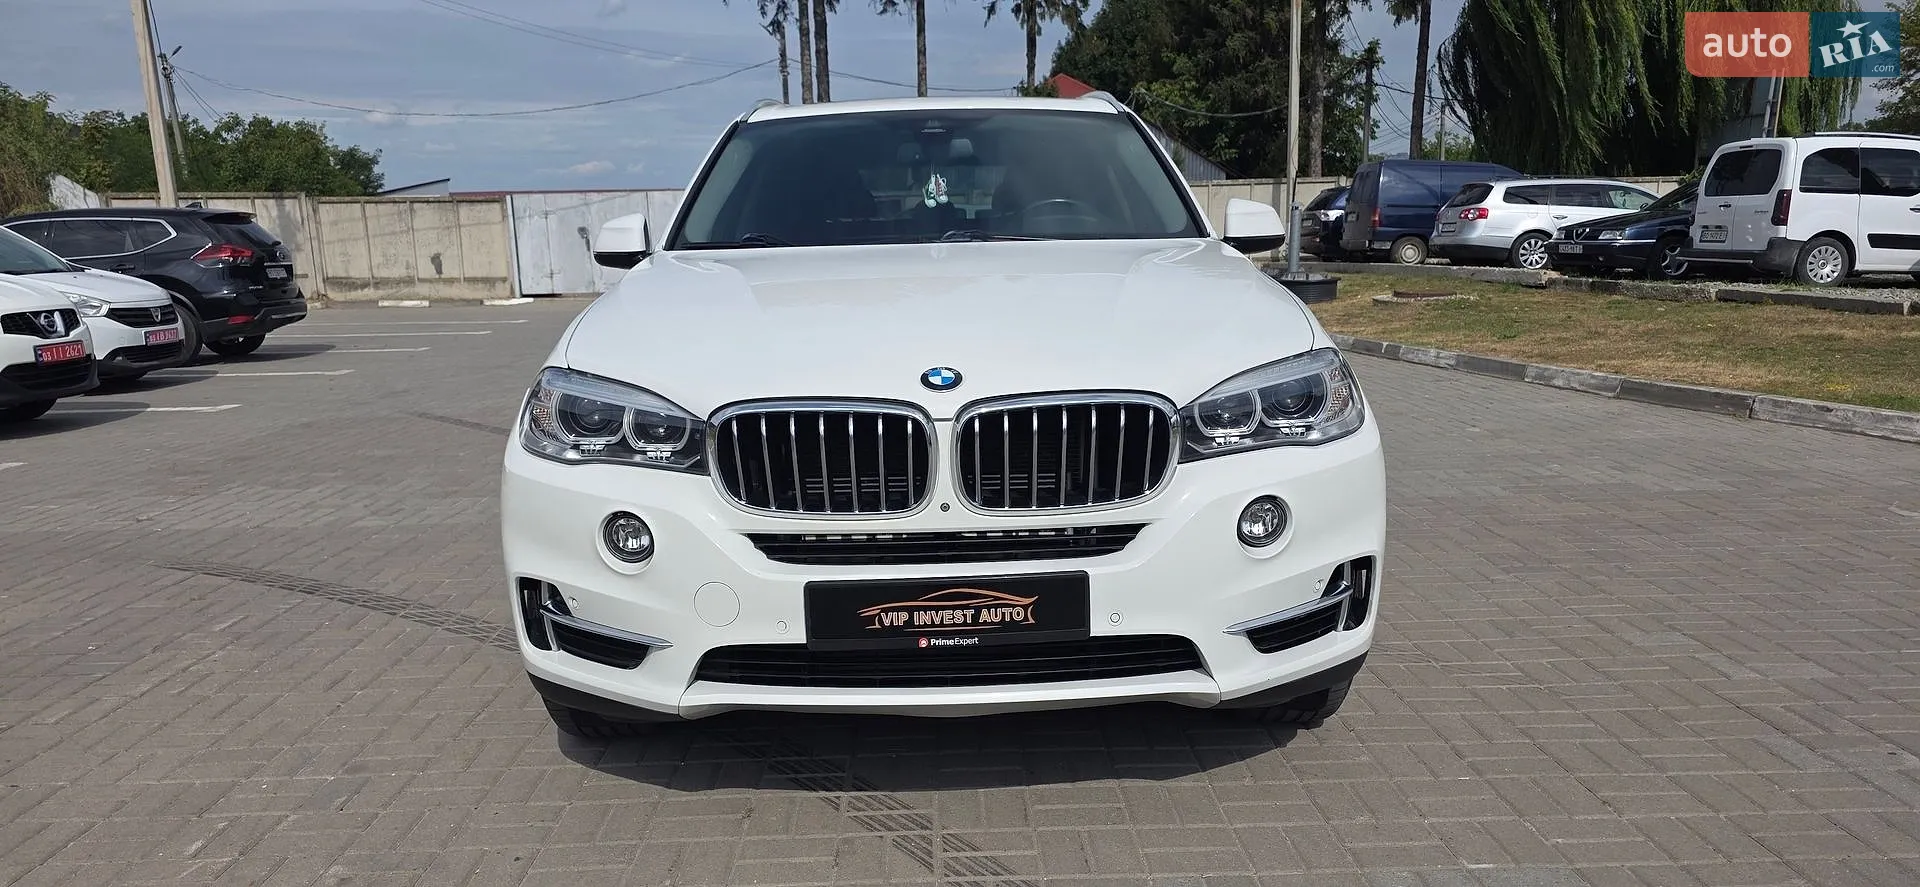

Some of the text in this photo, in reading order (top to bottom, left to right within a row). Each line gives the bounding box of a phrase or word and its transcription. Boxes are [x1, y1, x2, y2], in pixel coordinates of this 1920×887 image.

[42, 351, 52, 361] 03
[65, 344, 83, 357] 2621
[881, 607, 1024, 626] VIP INVEST AUTO
